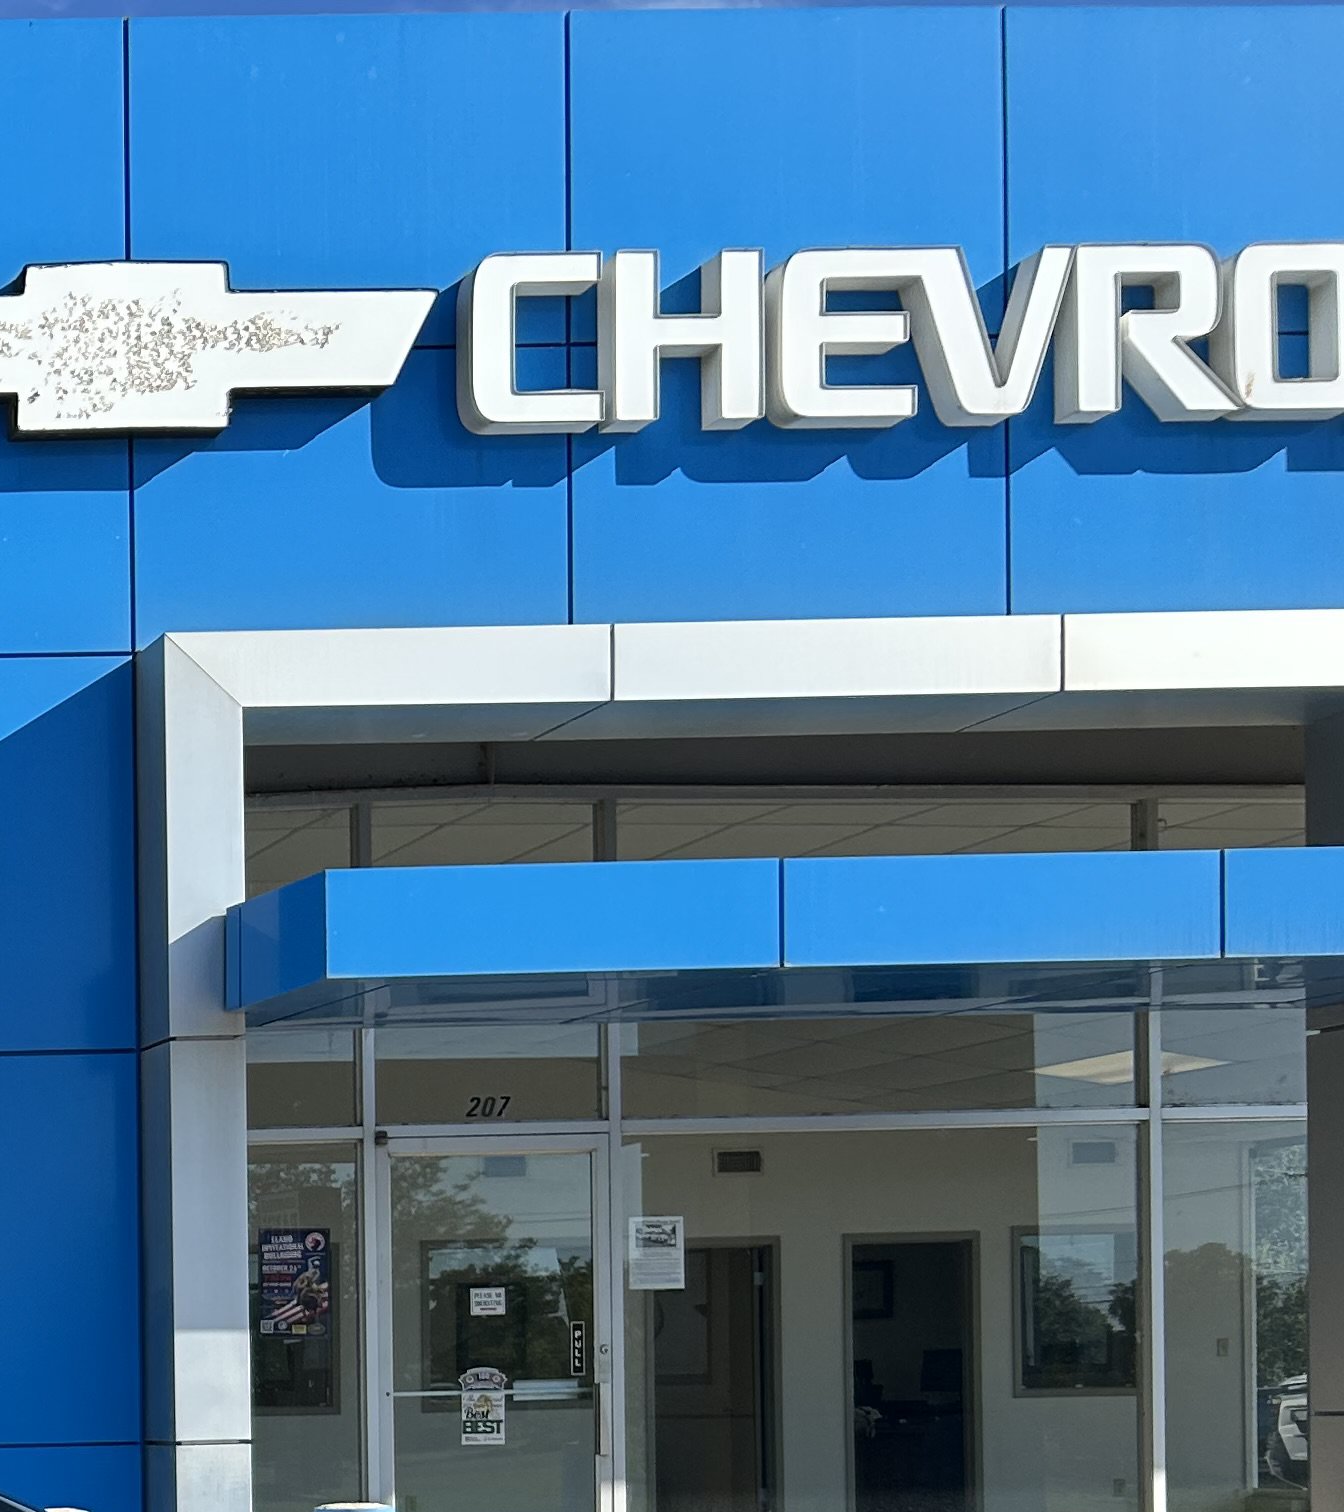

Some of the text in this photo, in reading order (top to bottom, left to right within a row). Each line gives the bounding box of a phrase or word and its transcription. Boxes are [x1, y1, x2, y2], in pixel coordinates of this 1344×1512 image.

[458, 243, 1344, 434] CHEVRO
[465, 1095, 511, 1117] 207
[574, 1330, 582, 1367] PULL
[462, 1420, 504, 1434] BEST
